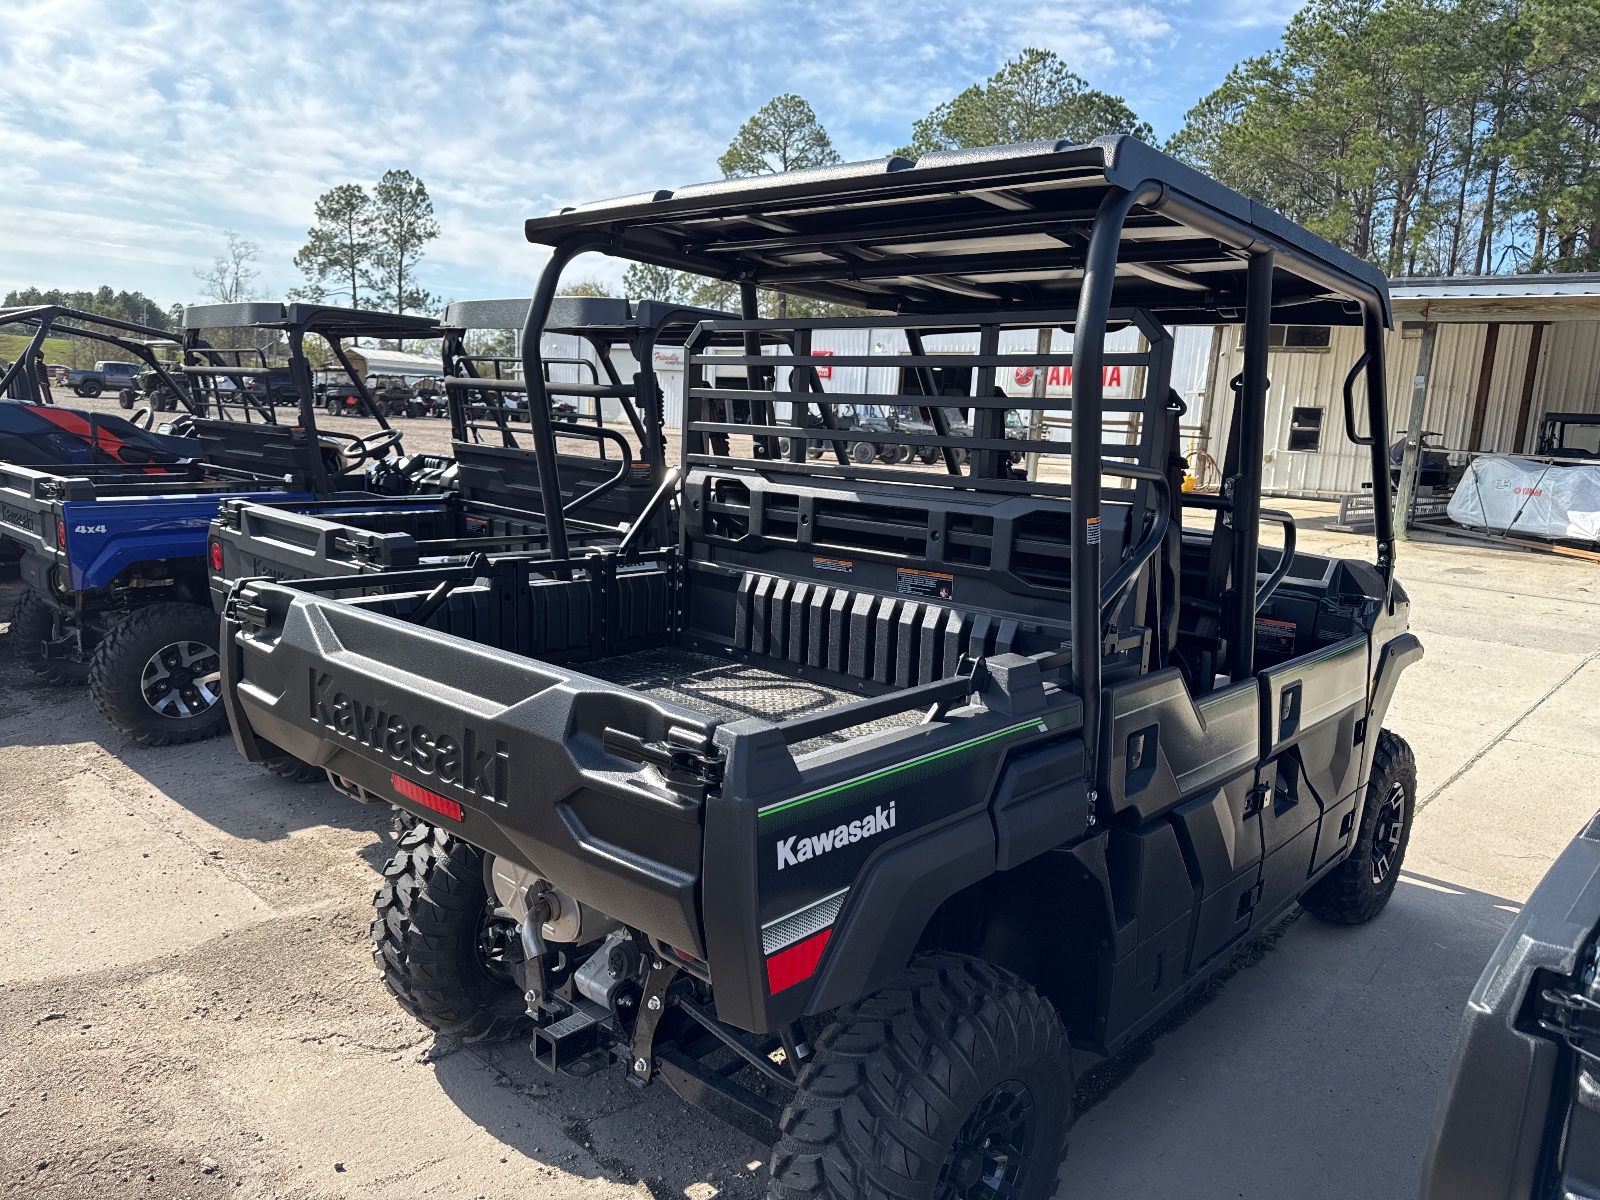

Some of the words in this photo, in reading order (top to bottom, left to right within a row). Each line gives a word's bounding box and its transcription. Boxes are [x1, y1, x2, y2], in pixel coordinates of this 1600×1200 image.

[75, 525, 108, 534] 4x4
[308, 666, 509, 807] Kawasaki
[776, 800, 896, 871] Kawasaki
